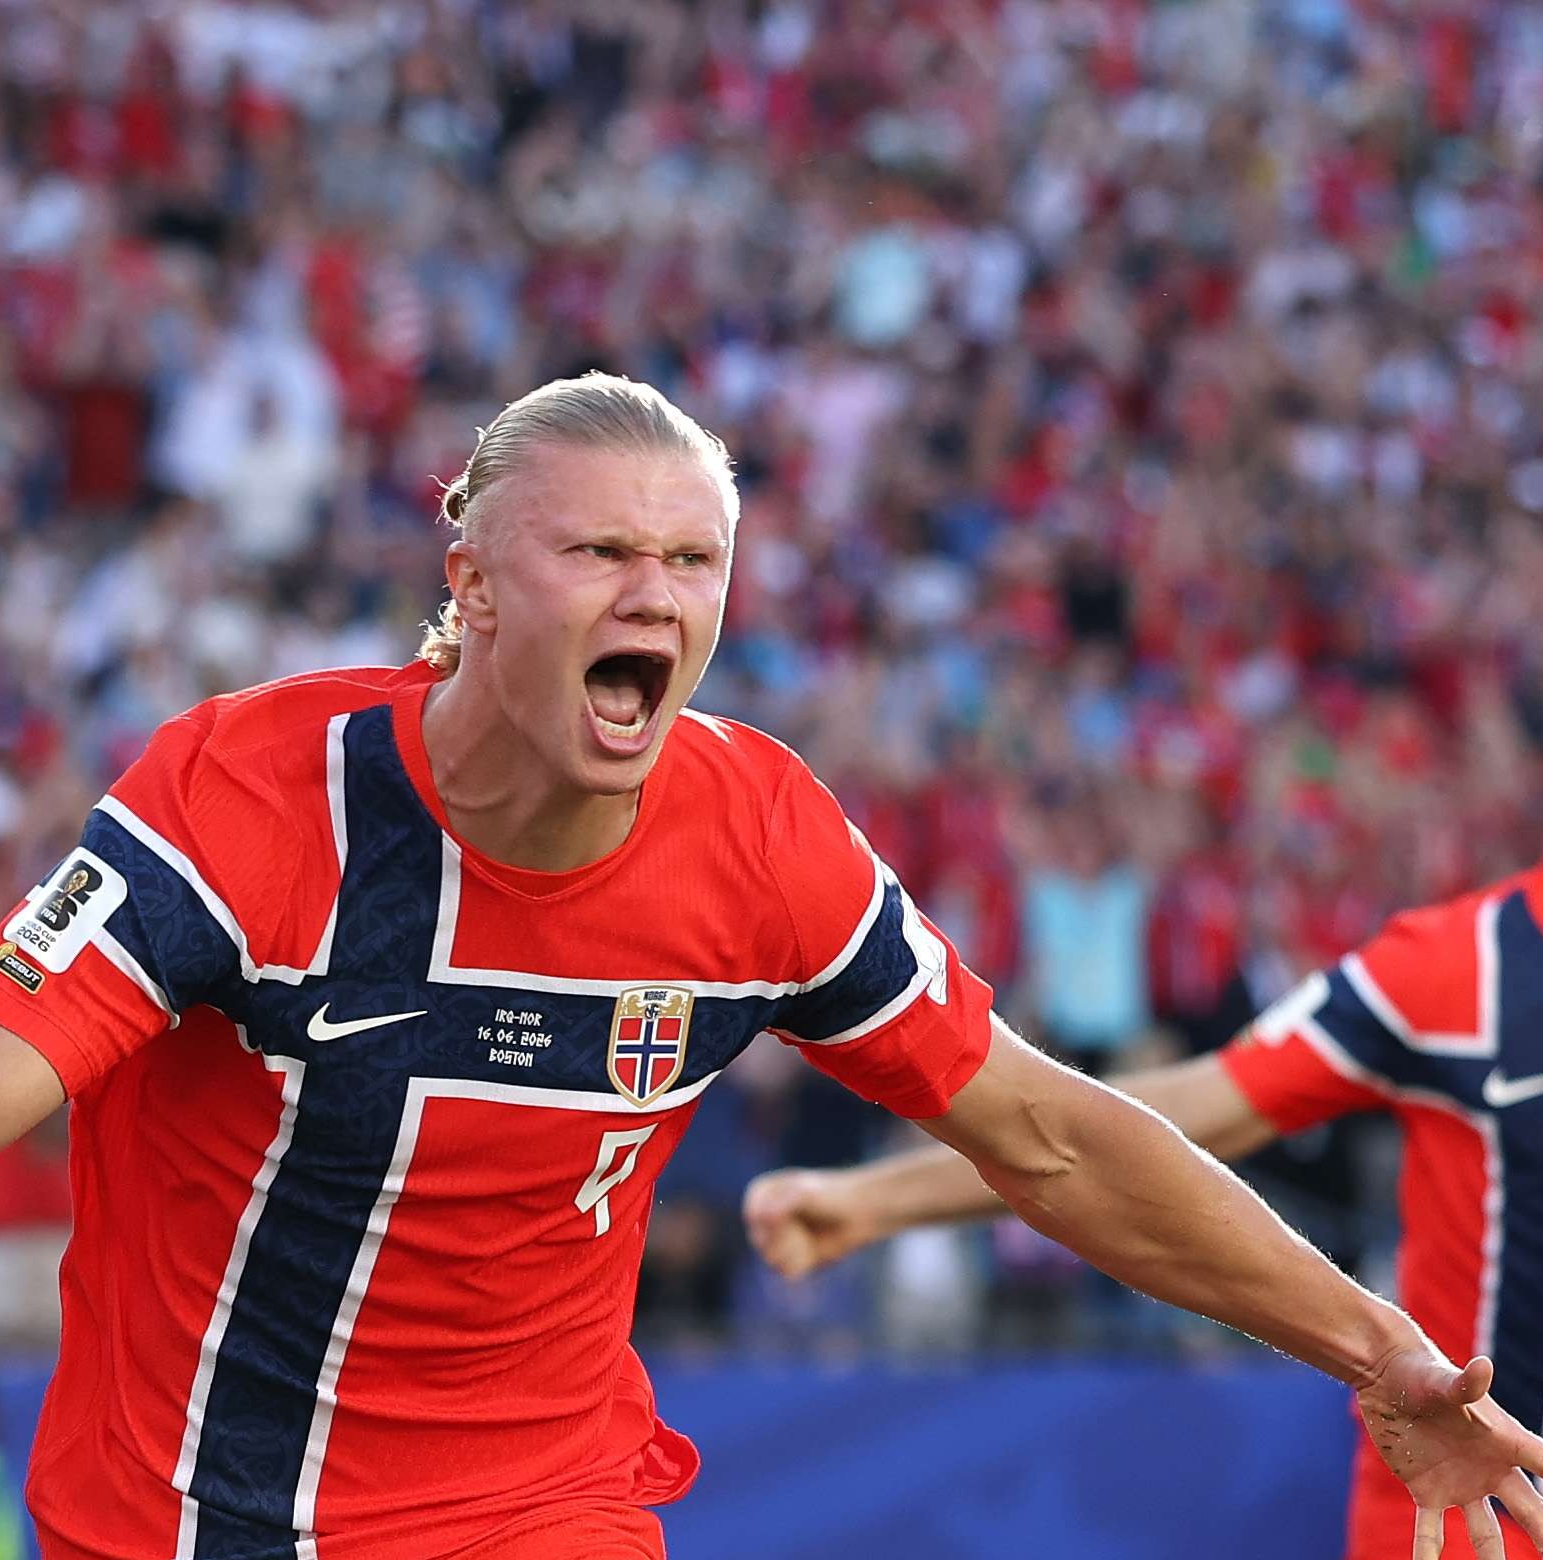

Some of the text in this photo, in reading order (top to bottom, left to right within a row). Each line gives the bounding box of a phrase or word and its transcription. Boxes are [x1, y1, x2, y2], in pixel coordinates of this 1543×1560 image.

[16, 926, 51, 953] 2026
[41, 929, 57, 943] CUP
[4, 956, 40, 983] DEBUT
[494, 1008, 543, 1027] IRQ-NOR
[488, 1047, 534, 1068] BOSTON
[574, 1122, 659, 1238] 9
